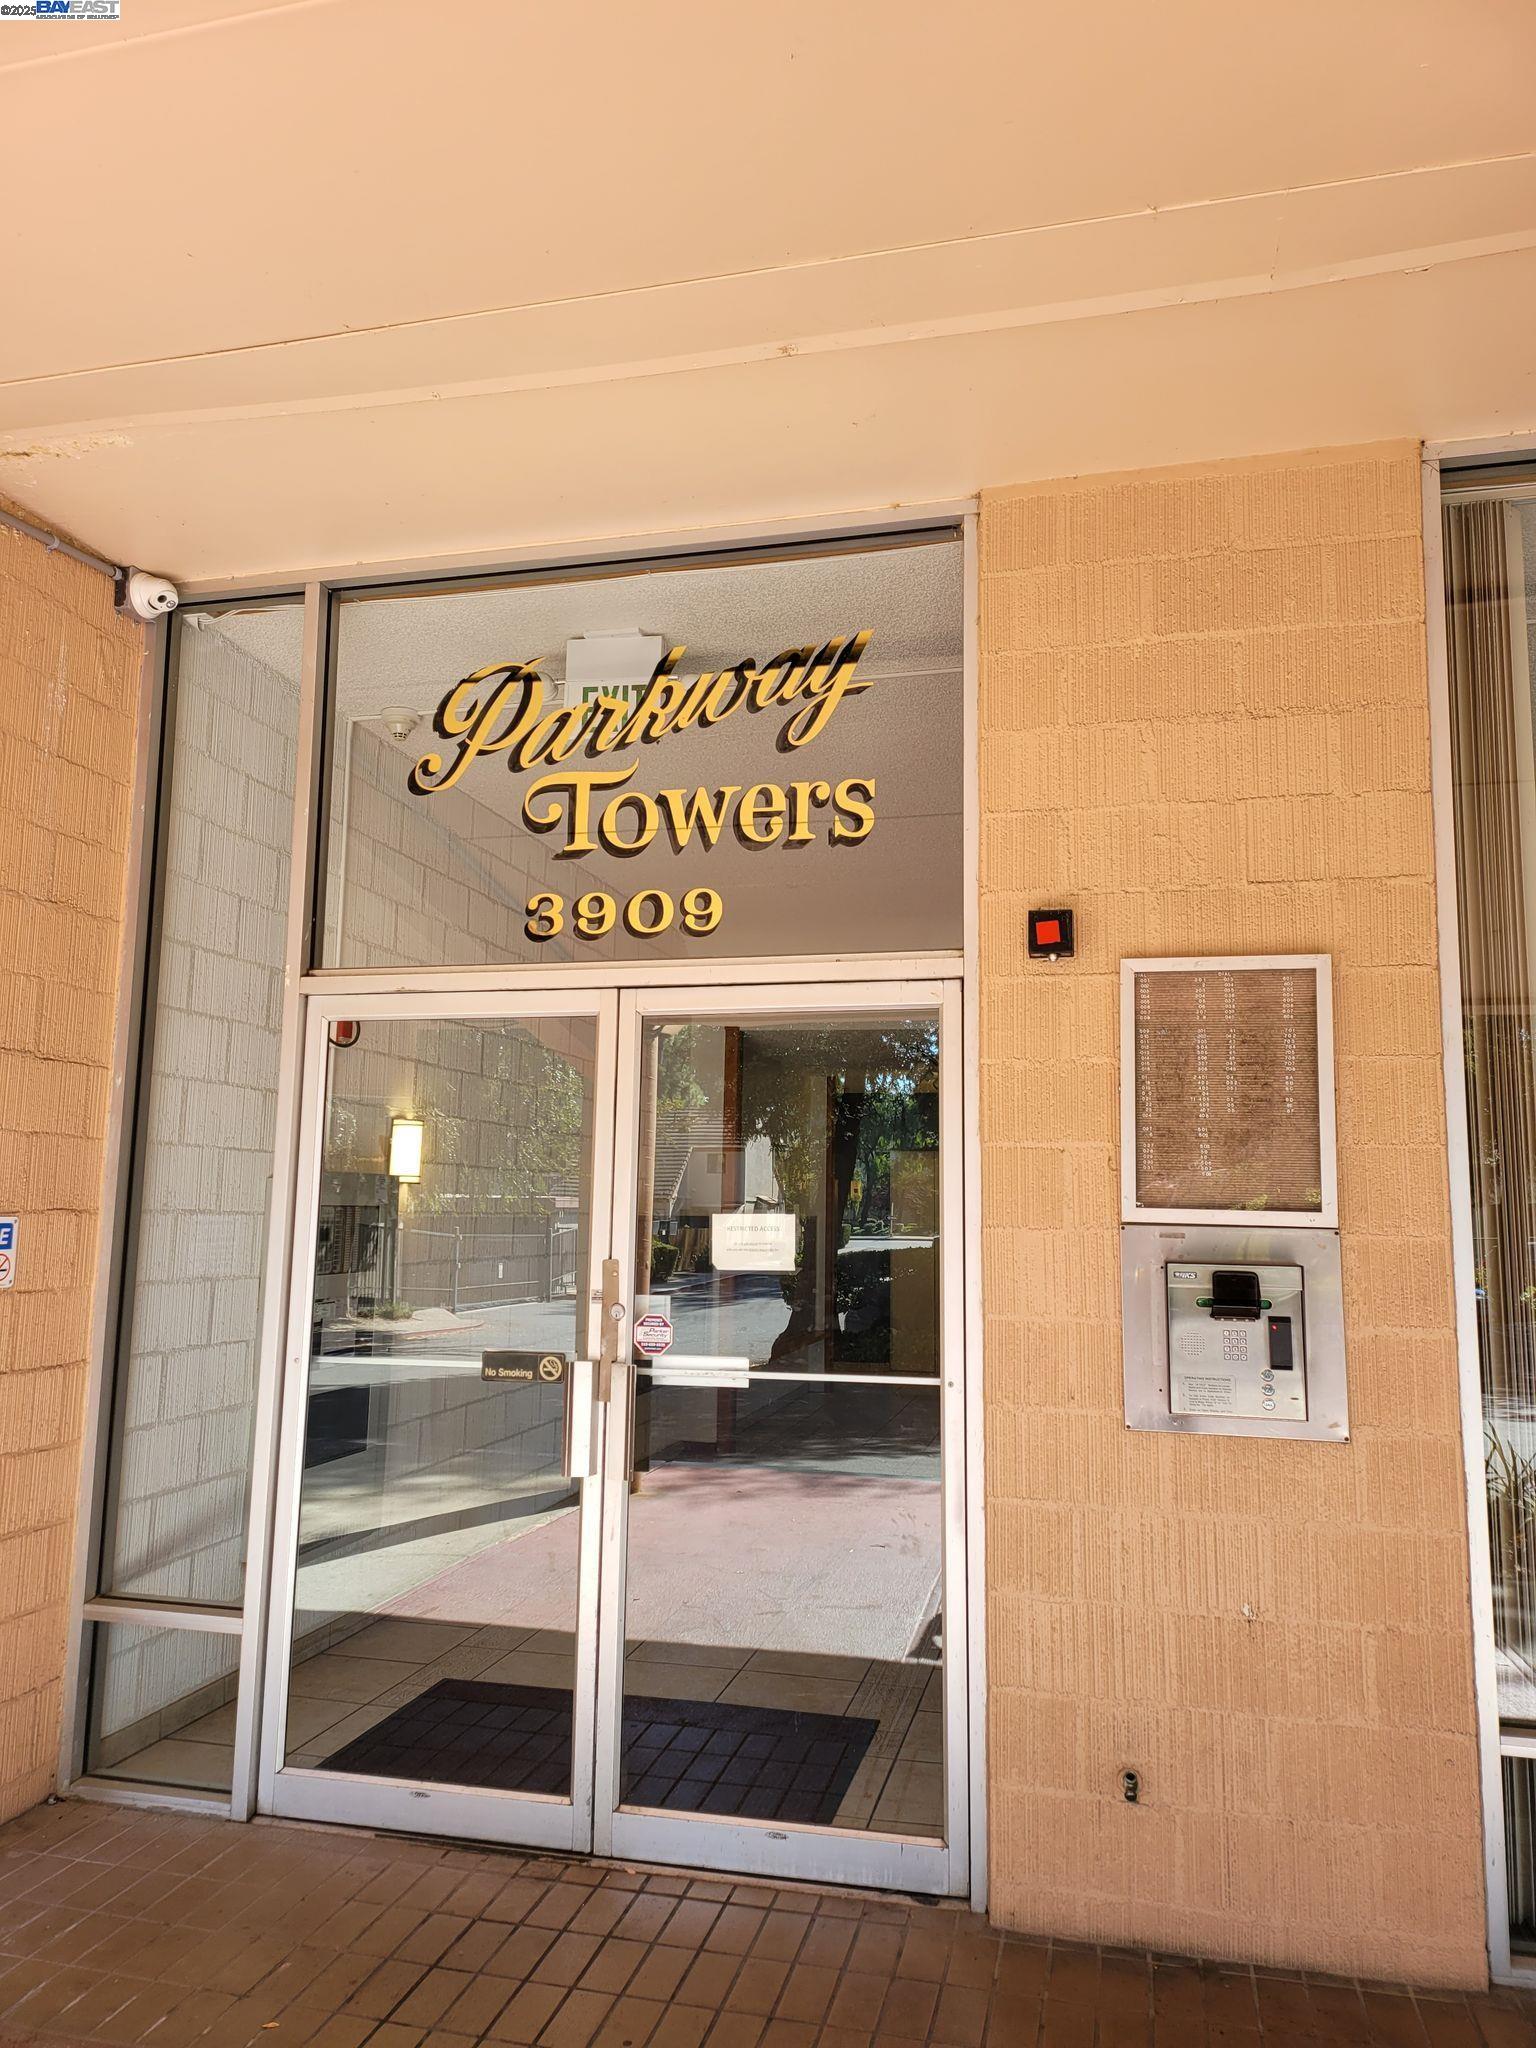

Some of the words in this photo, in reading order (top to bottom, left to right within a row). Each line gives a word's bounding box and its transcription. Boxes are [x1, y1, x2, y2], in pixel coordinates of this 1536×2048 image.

[407, 629, 874, 796] Parkway
[522, 756, 876, 860] Towers
[524, 887, 723, 943] 3909
[485, 1368, 496, 1377] No
[498, 1368, 533, 1380] Smoking
